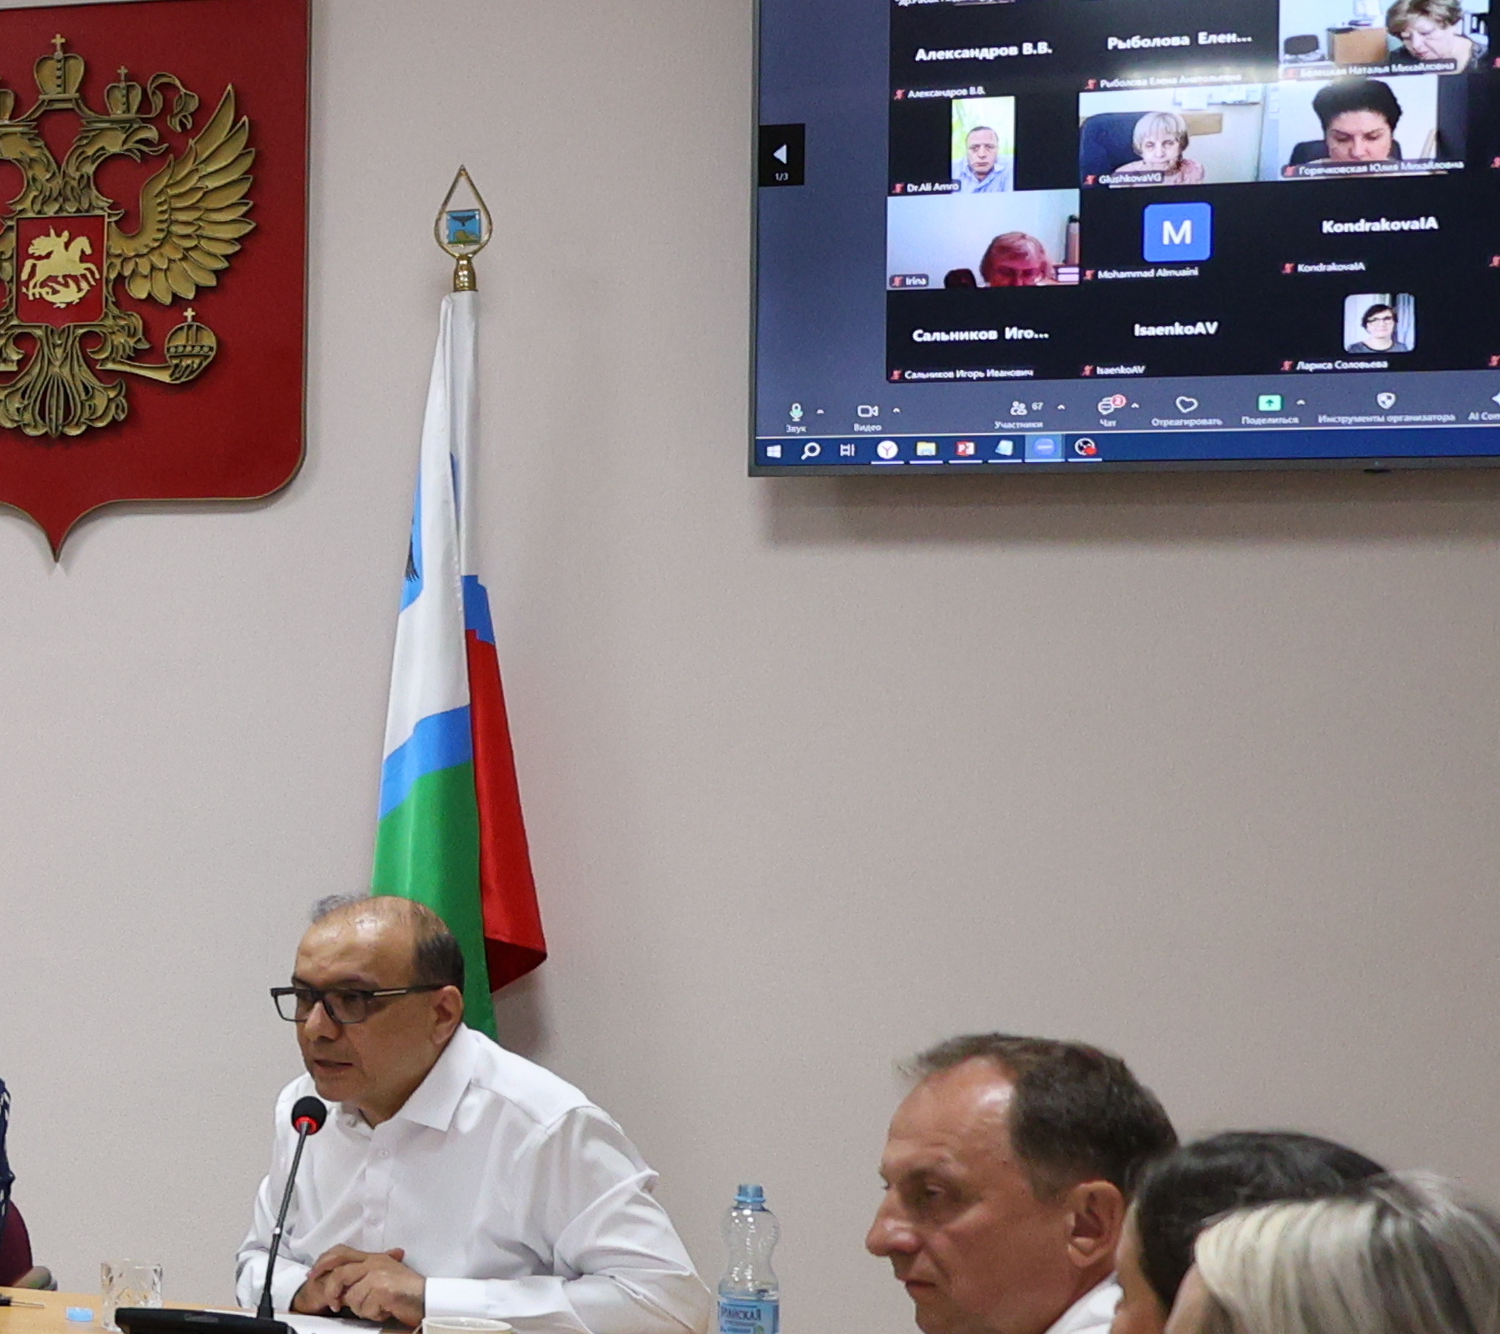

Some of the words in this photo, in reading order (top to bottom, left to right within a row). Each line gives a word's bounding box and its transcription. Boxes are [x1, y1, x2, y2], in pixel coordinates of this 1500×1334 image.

[1107, 34, 1190, 51] Рыболова
[1198, 32, 1252, 46] Елен...
[915, 43, 1019, 62] Александров
[1022, 41, 1053, 56] В.В.
[1100, 77, 1148, 90] Рыболова
[1149, 75, 1178, 87] Елена
[908, 87, 968, 99] Александров
[969, 86, 986, 96] В.В.
[775, 171, 789, 182] 1/3
[1099, 173, 1162, 185] GlushkovaVG
[906, 182, 932, 193] Dr.Ali
[933, 181, 960, 192] Amro
[1322, 217, 1439, 234] KondrakovaIA
[1161, 219, 1193, 246] M
[905, 274, 927, 286] Irina
[1097, 268, 1155, 280] Mohammad
[912, 328, 998, 343] Сальников
[1004, 326, 1049, 341] Иго...
[1133, 321, 1219, 337] IsaenkoAV
[1297, 360, 1332, 372] Лариса
[905, 369, 955, 380] Сальников
[955, 368, 984, 380] Игорь
[1152, 417, 1223, 428] Отреагировать
[1241, 414, 1299, 426] Поделиться
[1318, 413, 1385, 425] Инструменты
[1386, 411, 1456, 425] организатора
[786, 424, 806, 434] Звук
[854, 423, 882, 433] Видео
[994, 419, 1044, 430] Участники
